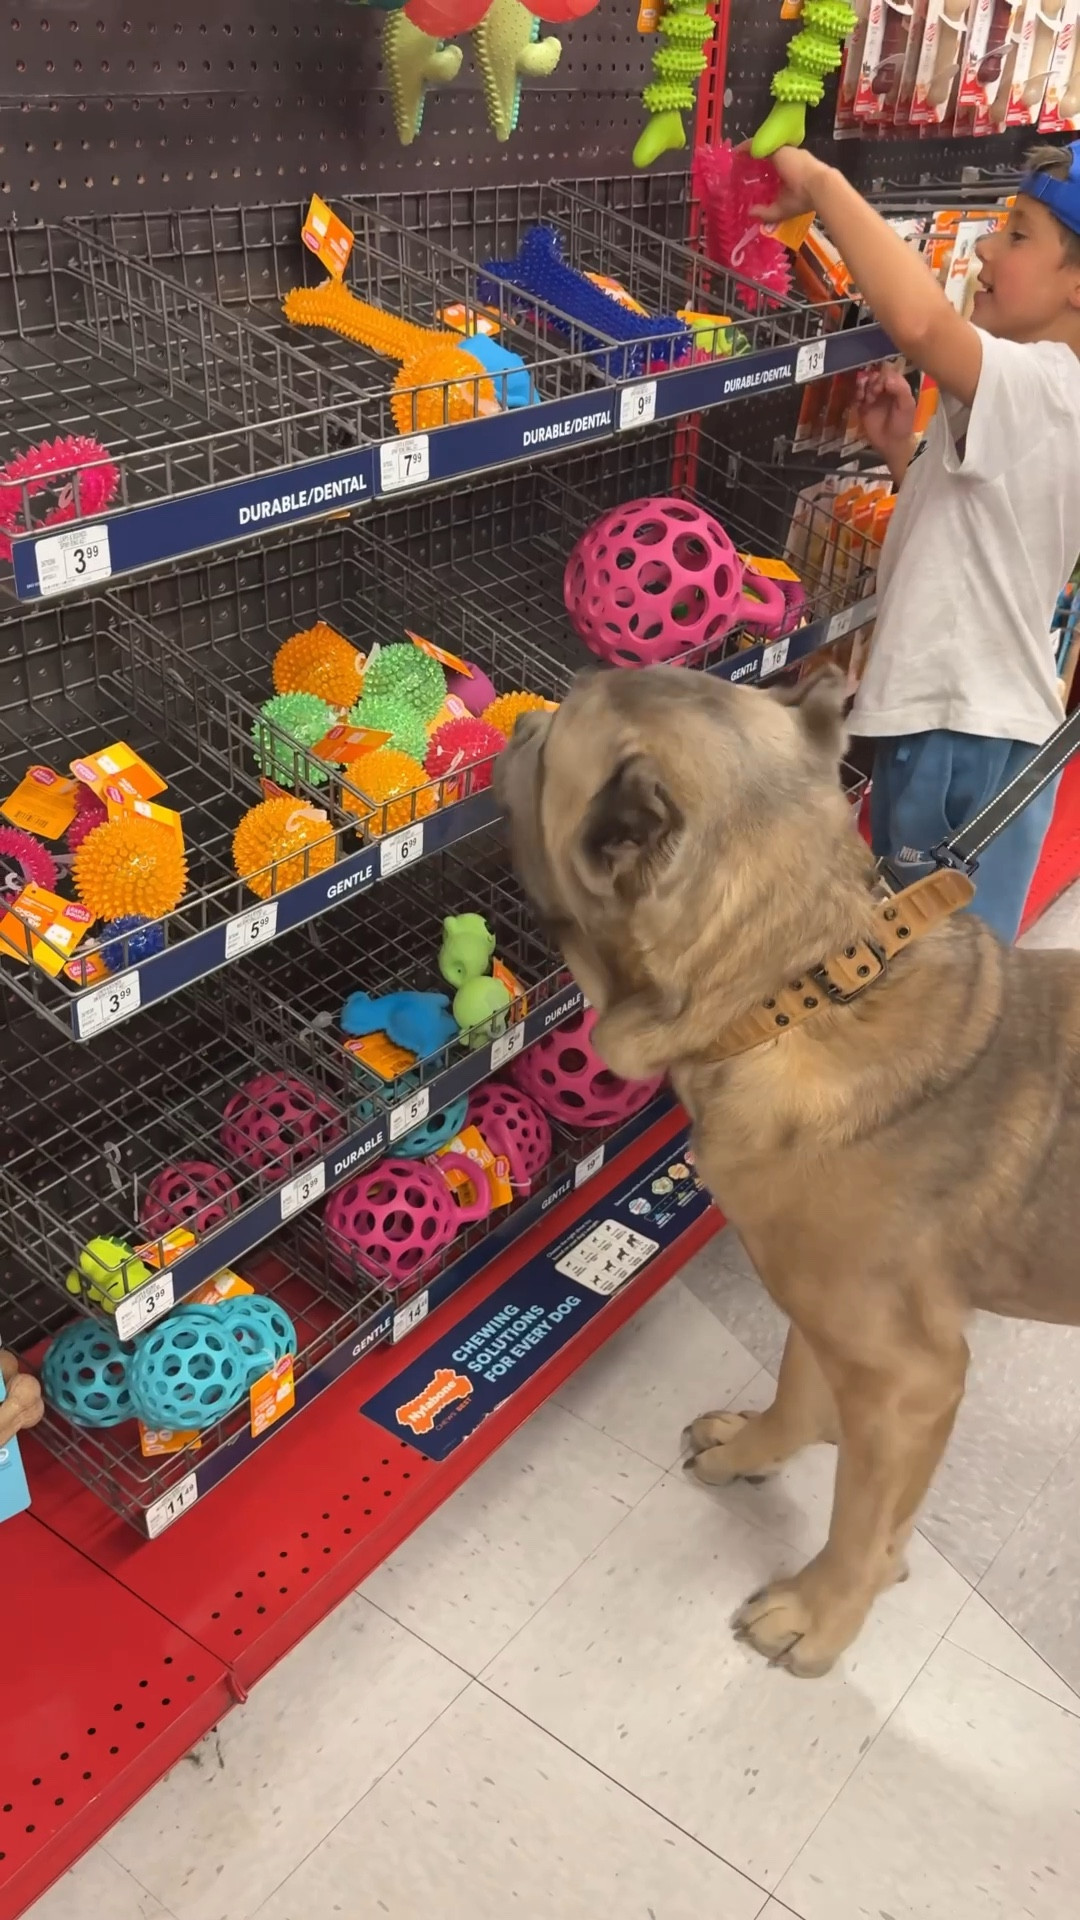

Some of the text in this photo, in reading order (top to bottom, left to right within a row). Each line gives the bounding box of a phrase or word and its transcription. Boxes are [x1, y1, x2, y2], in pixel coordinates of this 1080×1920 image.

[724, 364, 792, 394] DURABLE/DENTAL
[523, 410, 611, 446] DURABLE/DENTAL
[239, 474, 367, 525] DURABLE/DENTAL
[731, 659, 759, 681] GENTLE
[327, 865, 373, 899] GENTLE
[545, 992, 581, 1026] DURABLE
[334, 1131, 383, 1176] DURABLE
[541, 1179, 571, 1209] GENTLE
[352, 1316, 391, 1357] GENTLE
[452, 1304, 520, 1362] CHEWING
[467, 1305, 545, 1373] SOLUTIONS
[483, 1295, 582, 1383] FOR EVERY DOG
[408, 1380, 457, 1422] Nylabone
